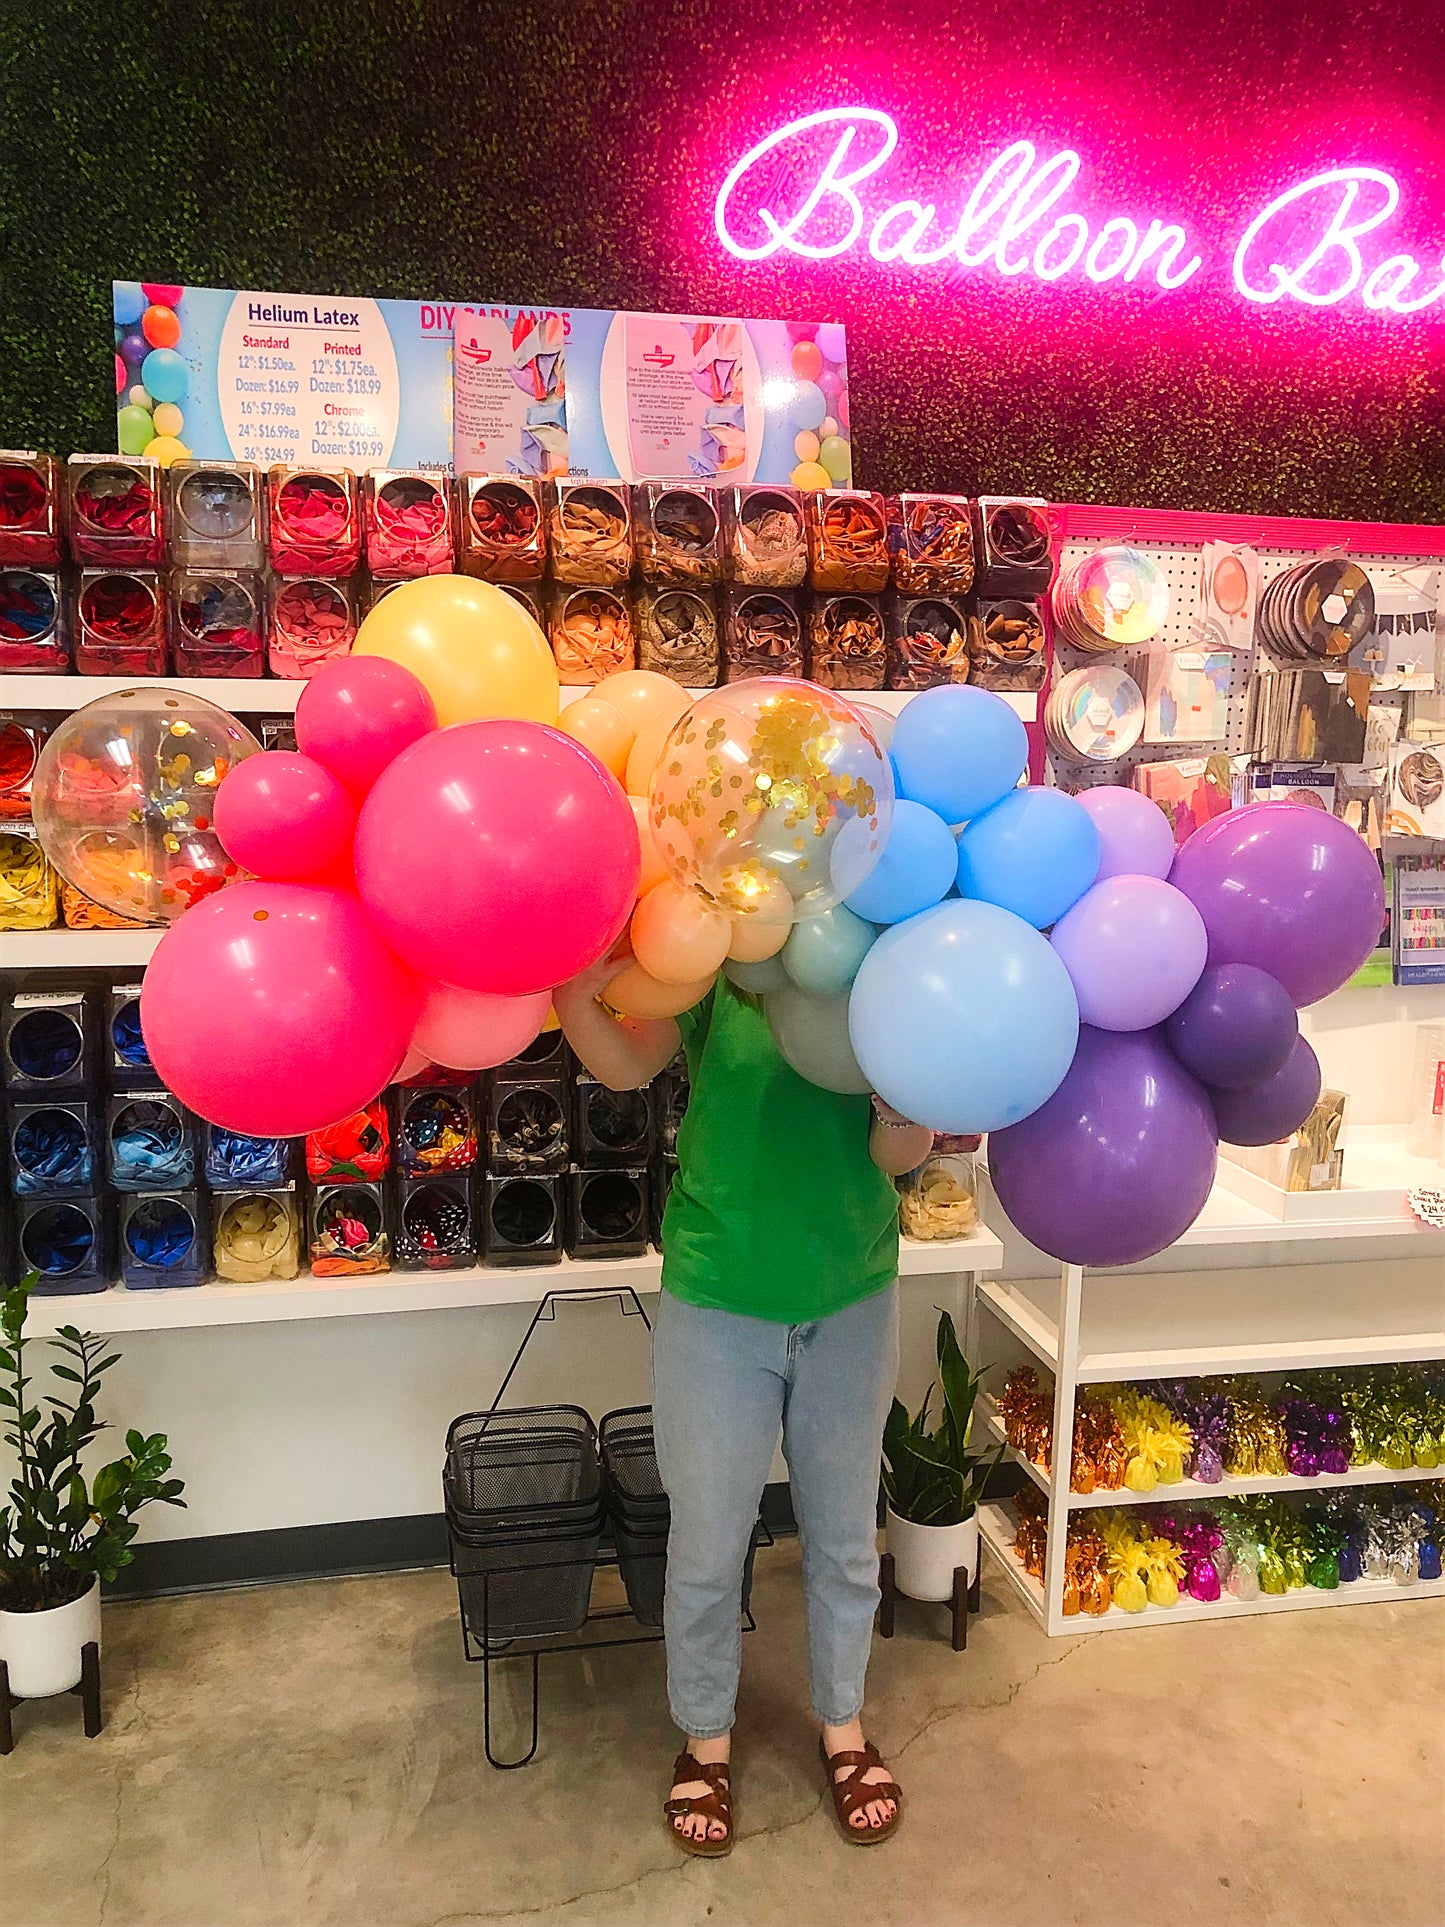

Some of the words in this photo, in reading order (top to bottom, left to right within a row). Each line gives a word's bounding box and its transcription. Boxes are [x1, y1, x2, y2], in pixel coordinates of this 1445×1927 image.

[714, 106, 1201, 290] Balloon
[1232, 167, 1445, 313] Ba
[248, 303, 308, 323] Helium
[314, 307, 359, 326] Latex
[421, 305, 455, 330] DIY
[242, 334, 289, 349] Standard
[324, 342, 361, 355] Printed
[235, 377, 267, 392] Dozen:
[269, 379, 299, 393] $16.99
[309, 377, 345, 393] Dozen:
[347, 377, 381, 394] $18.99
[324, 403, 365, 416] Chrome
[264, 446, 295, 461] $24.99
[311, 439, 347, 455] Dozen:
[348, 439, 383, 456] $19.99
